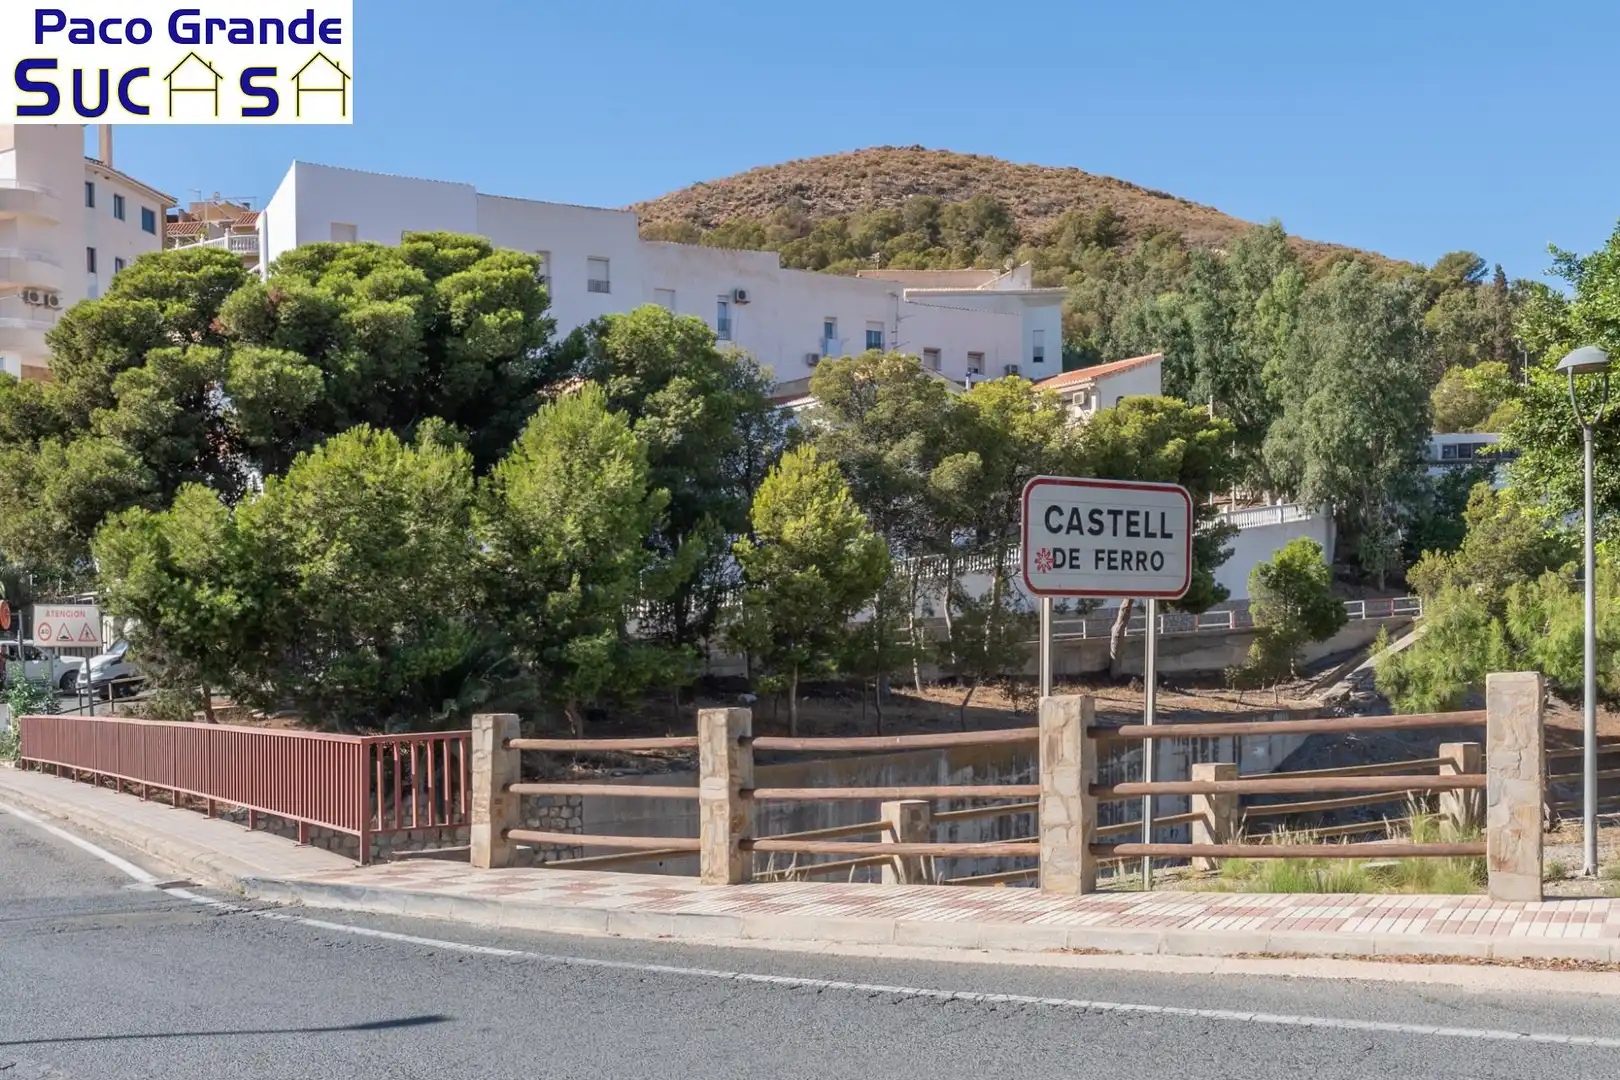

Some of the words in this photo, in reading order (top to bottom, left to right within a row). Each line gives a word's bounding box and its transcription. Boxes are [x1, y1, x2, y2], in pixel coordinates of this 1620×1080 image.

[1044, 505, 1174, 539] CASTELL
[1051, 547, 1081, 570] DE
[1094, 549, 1165, 571] FERRO
